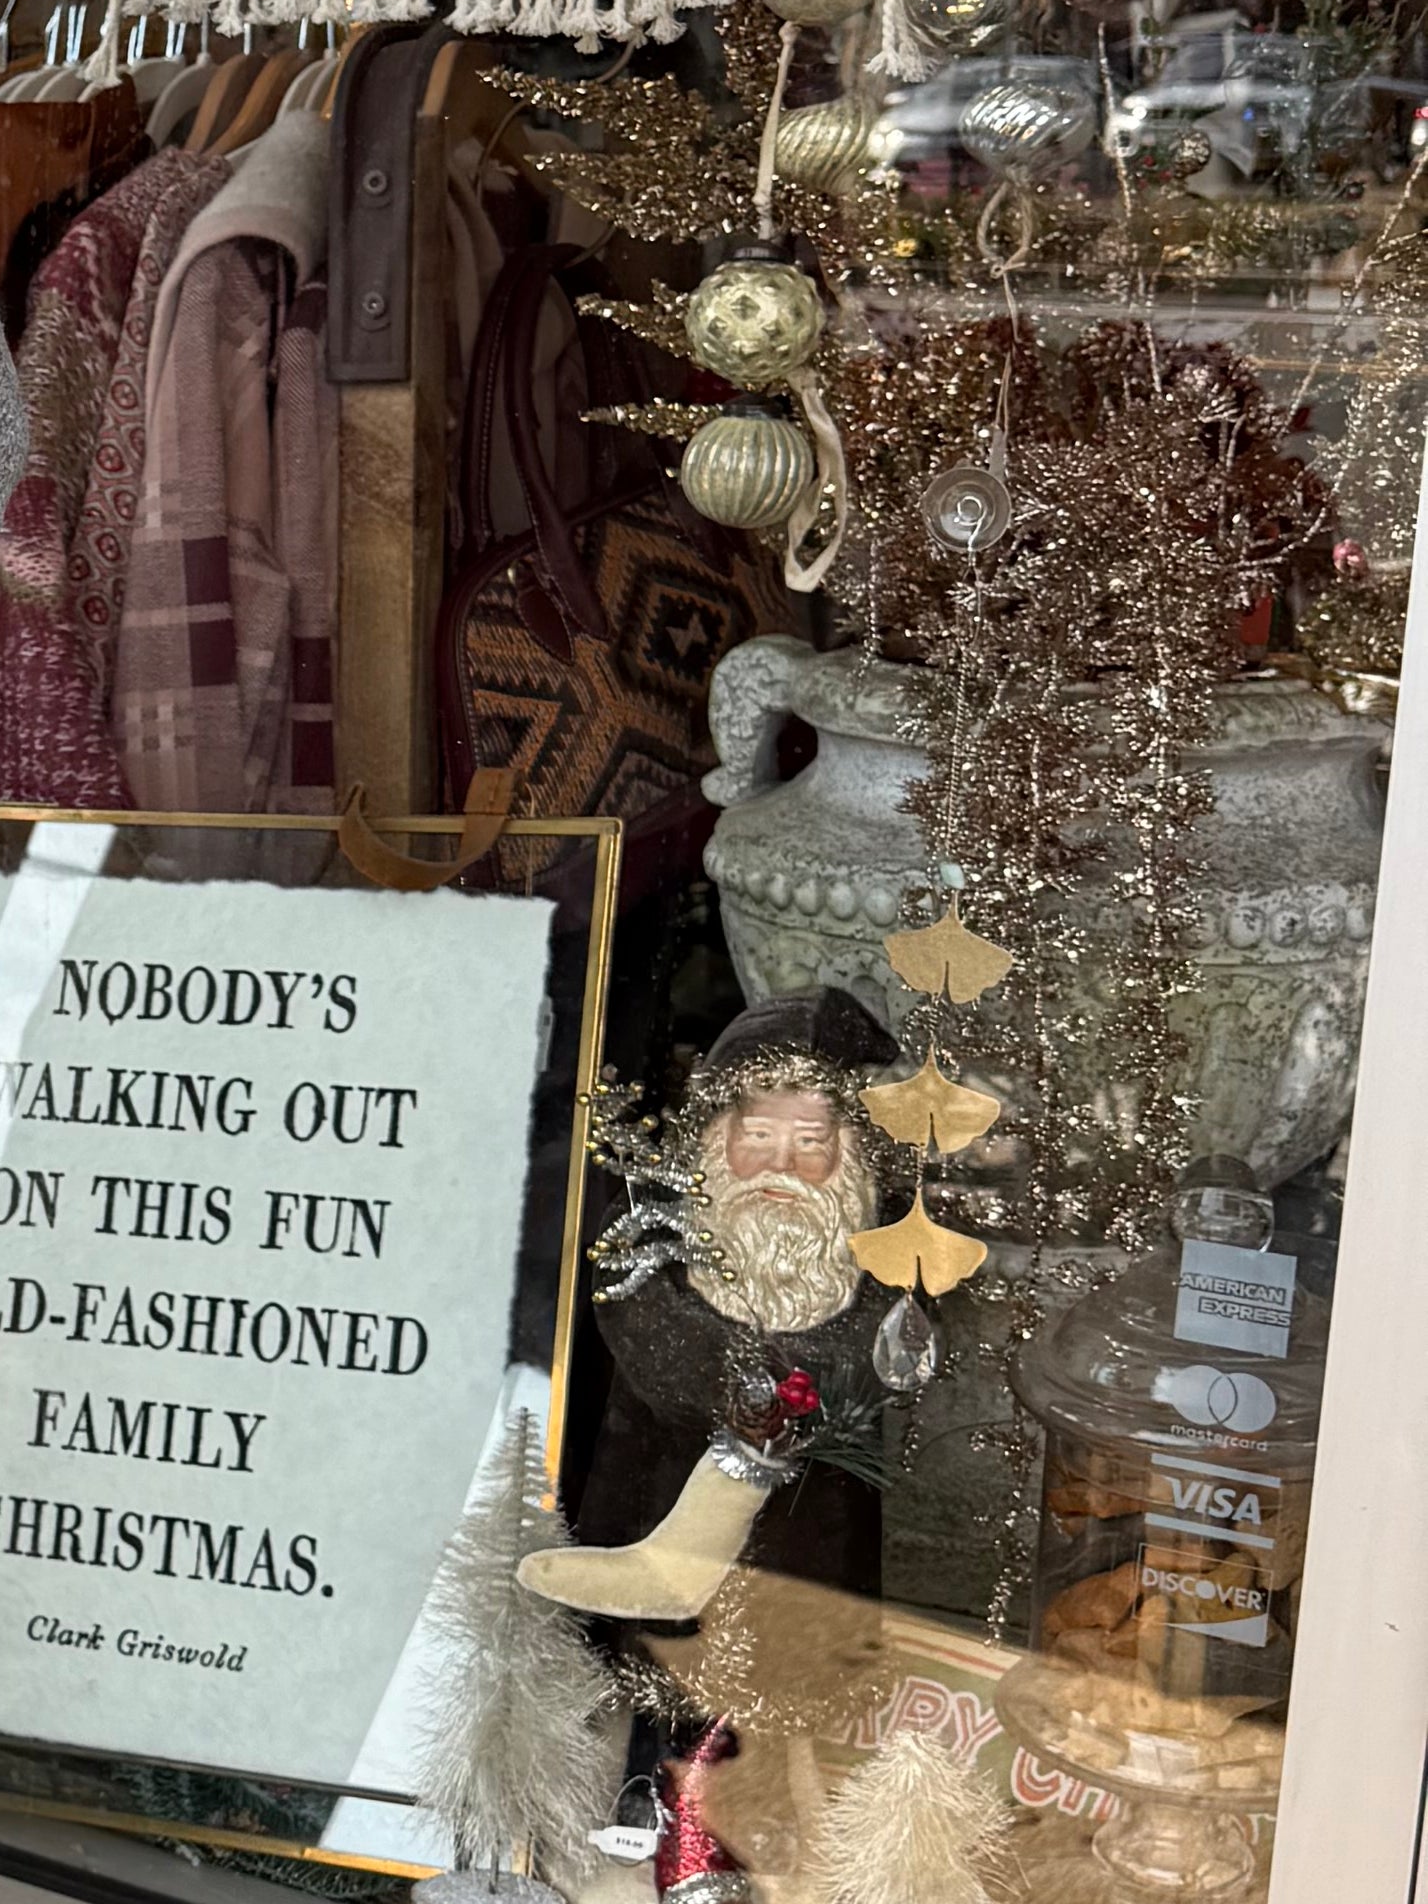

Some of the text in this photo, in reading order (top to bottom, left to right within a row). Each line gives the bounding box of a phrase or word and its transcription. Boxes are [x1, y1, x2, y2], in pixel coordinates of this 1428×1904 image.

[53, 959, 358, 1035] NOBODY'S
[282, 1081, 418, 1149] OUT
[91, 1174, 234, 1246] THIS
[259, 1189, 392, 1259] FUN
[1179, 1273, 1286, 1305] AMERICAN
[1199, 1297, 1293, 1327] EXPRESS
[26, 1387, 267, 1474] FAMILY
[1170, 1423, 1268, 1452] mastercard
[1161, 1474, 1262, 1526] VISA
[1141, 1566, 1263, 1611] DISCOVER
[26, 1613, 249, 1675] Clark Griswold
